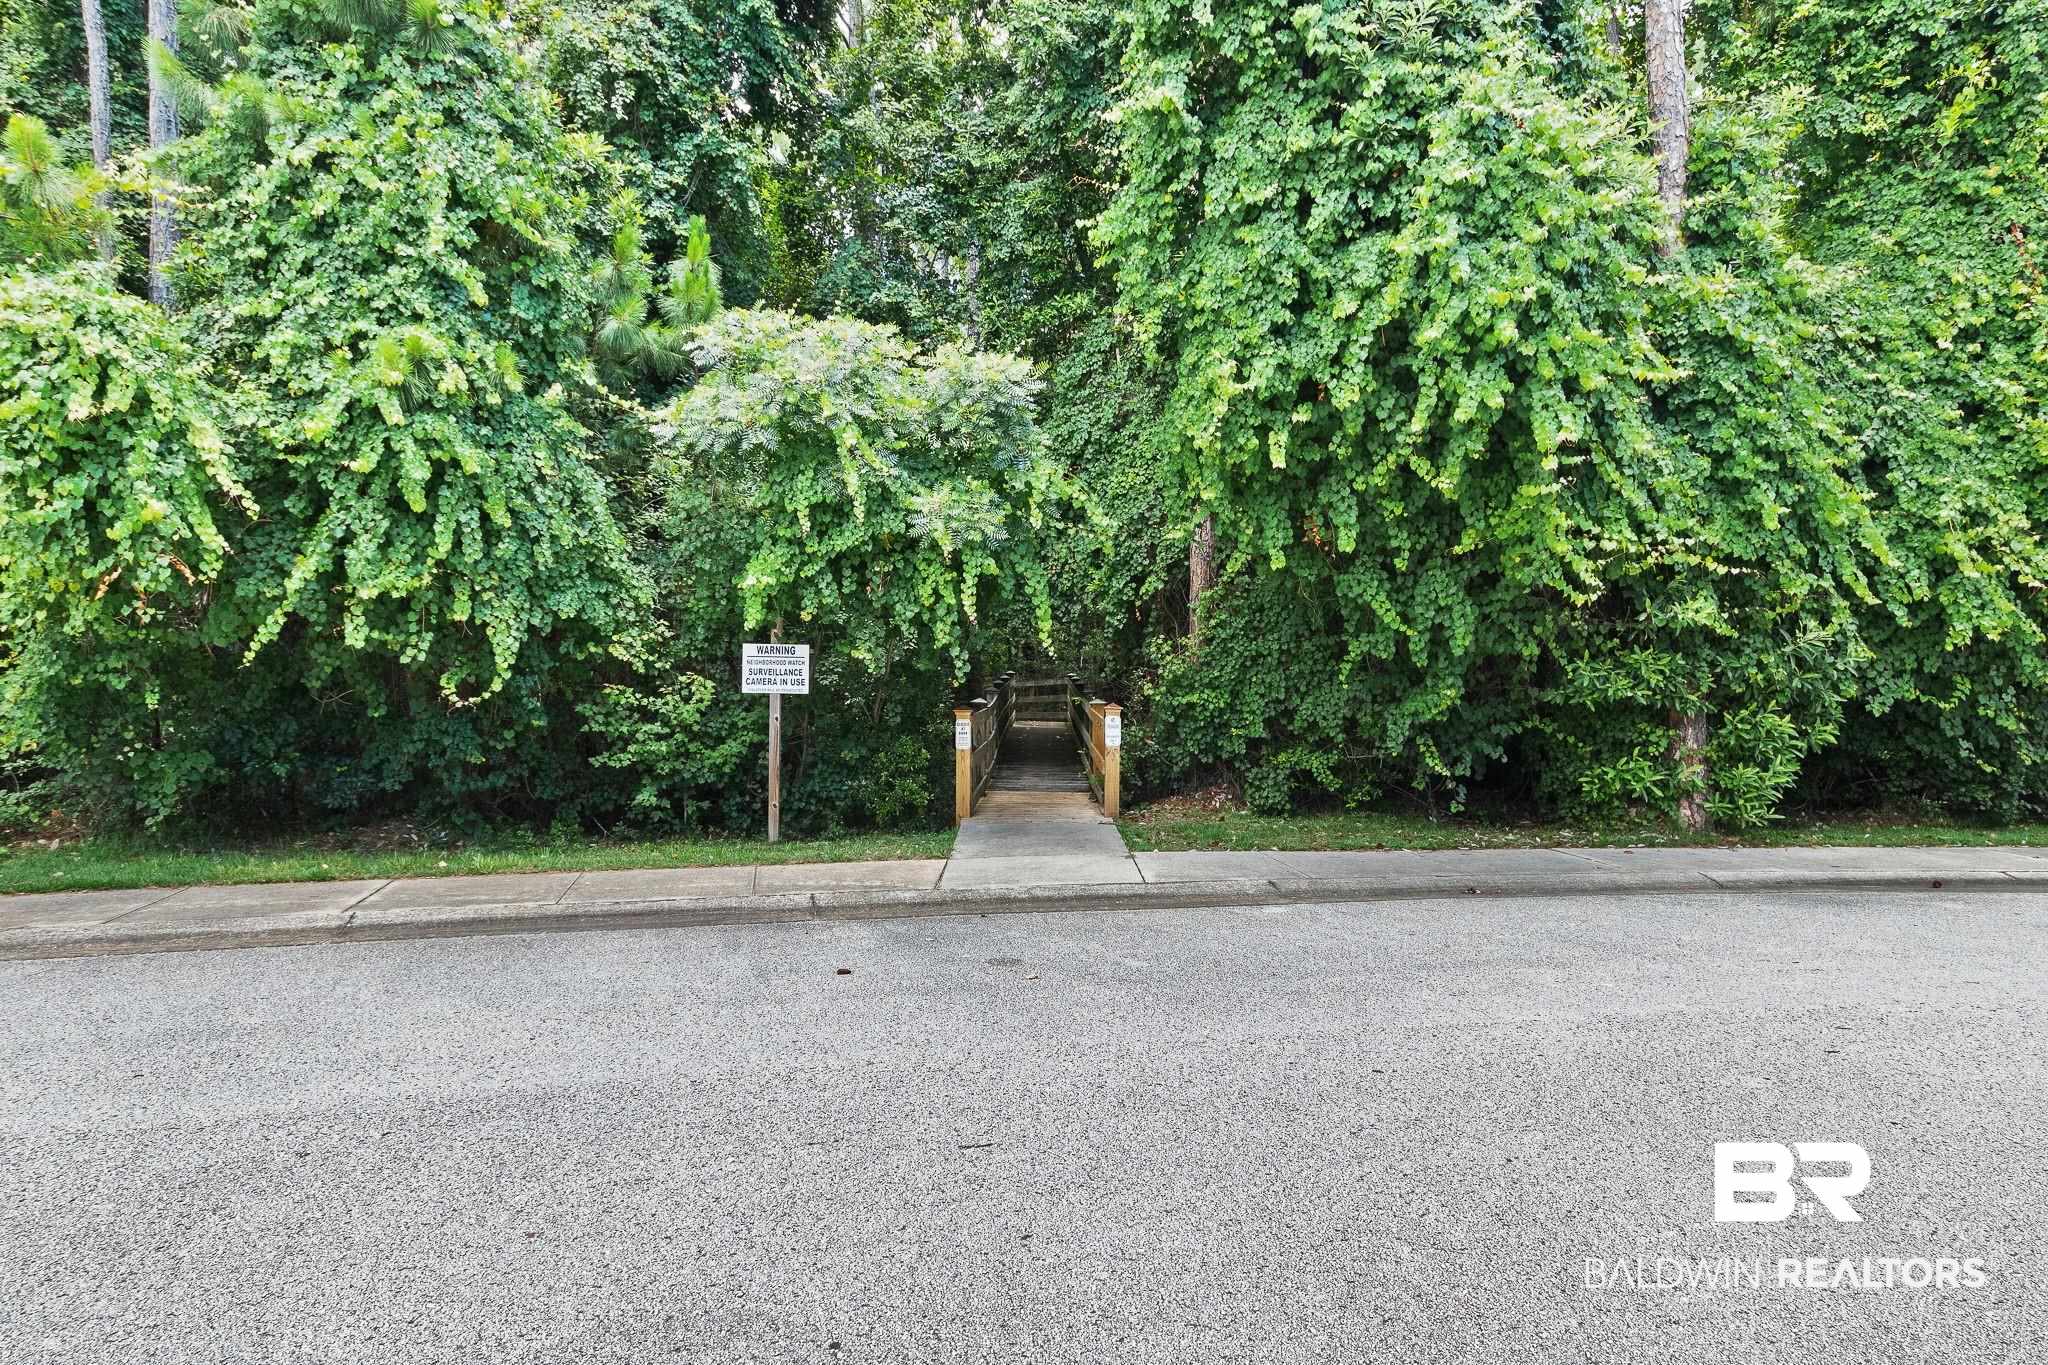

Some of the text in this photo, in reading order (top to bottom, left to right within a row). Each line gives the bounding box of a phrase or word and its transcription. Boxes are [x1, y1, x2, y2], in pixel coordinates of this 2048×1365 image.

[757, 645, 796, 655] WARNING
[748, 668, 803, 676] SURVEILLANCE
[746, 678, 806, 686] CAMERA IN USE
